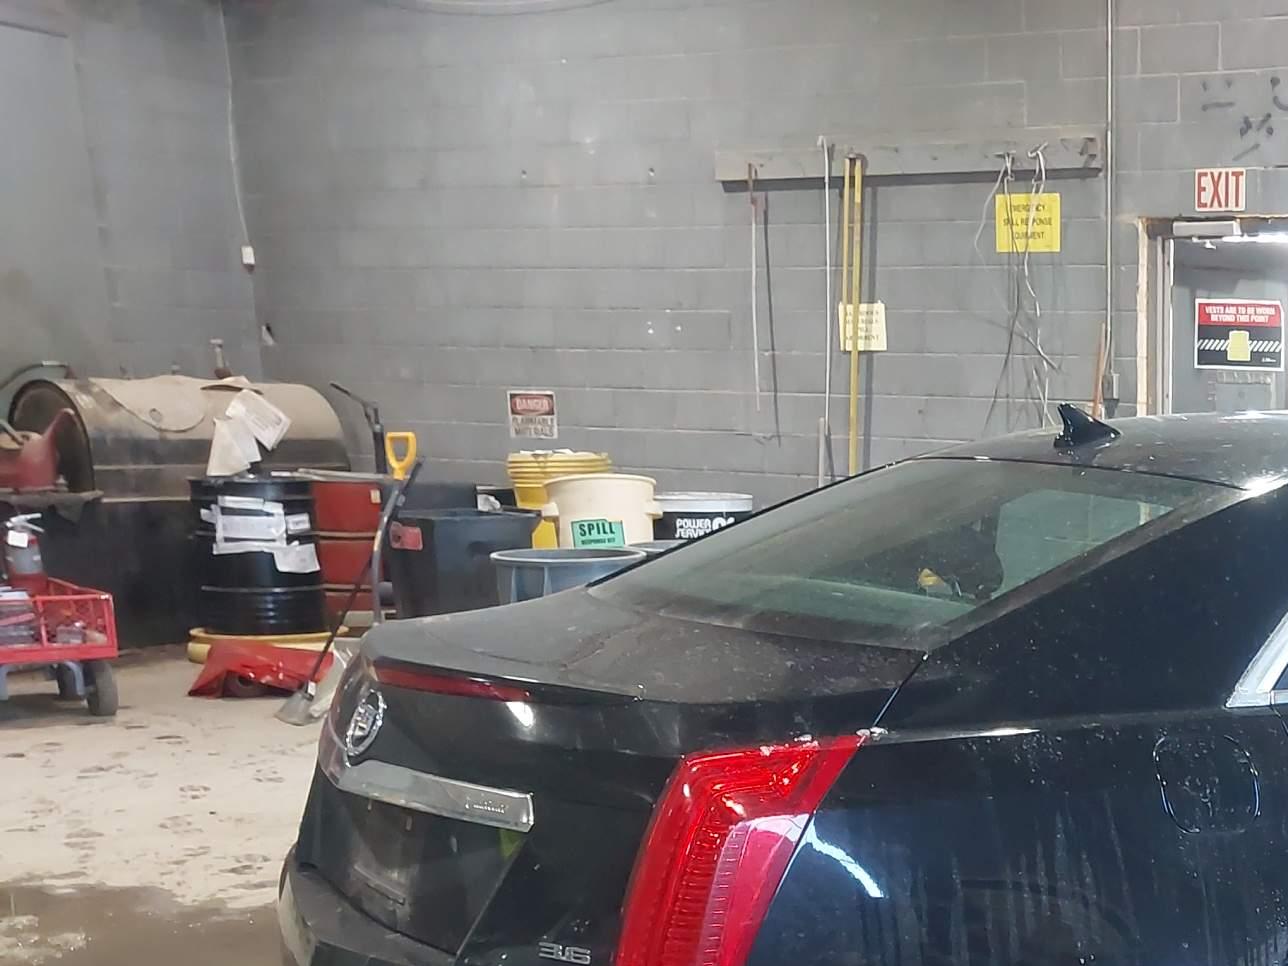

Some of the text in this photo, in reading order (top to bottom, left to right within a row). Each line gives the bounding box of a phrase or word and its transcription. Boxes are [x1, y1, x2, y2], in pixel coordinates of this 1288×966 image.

[1197, 171, 1244, 209] EXIT
[1205, 305, 1275, 316] VESTS ARE TO BE WORN
[1211, 314, 1269, 323] BEYOND THIS POINT
[675, 518, 711, 528] POWER
[579, 522, 615, 537] SPILL
